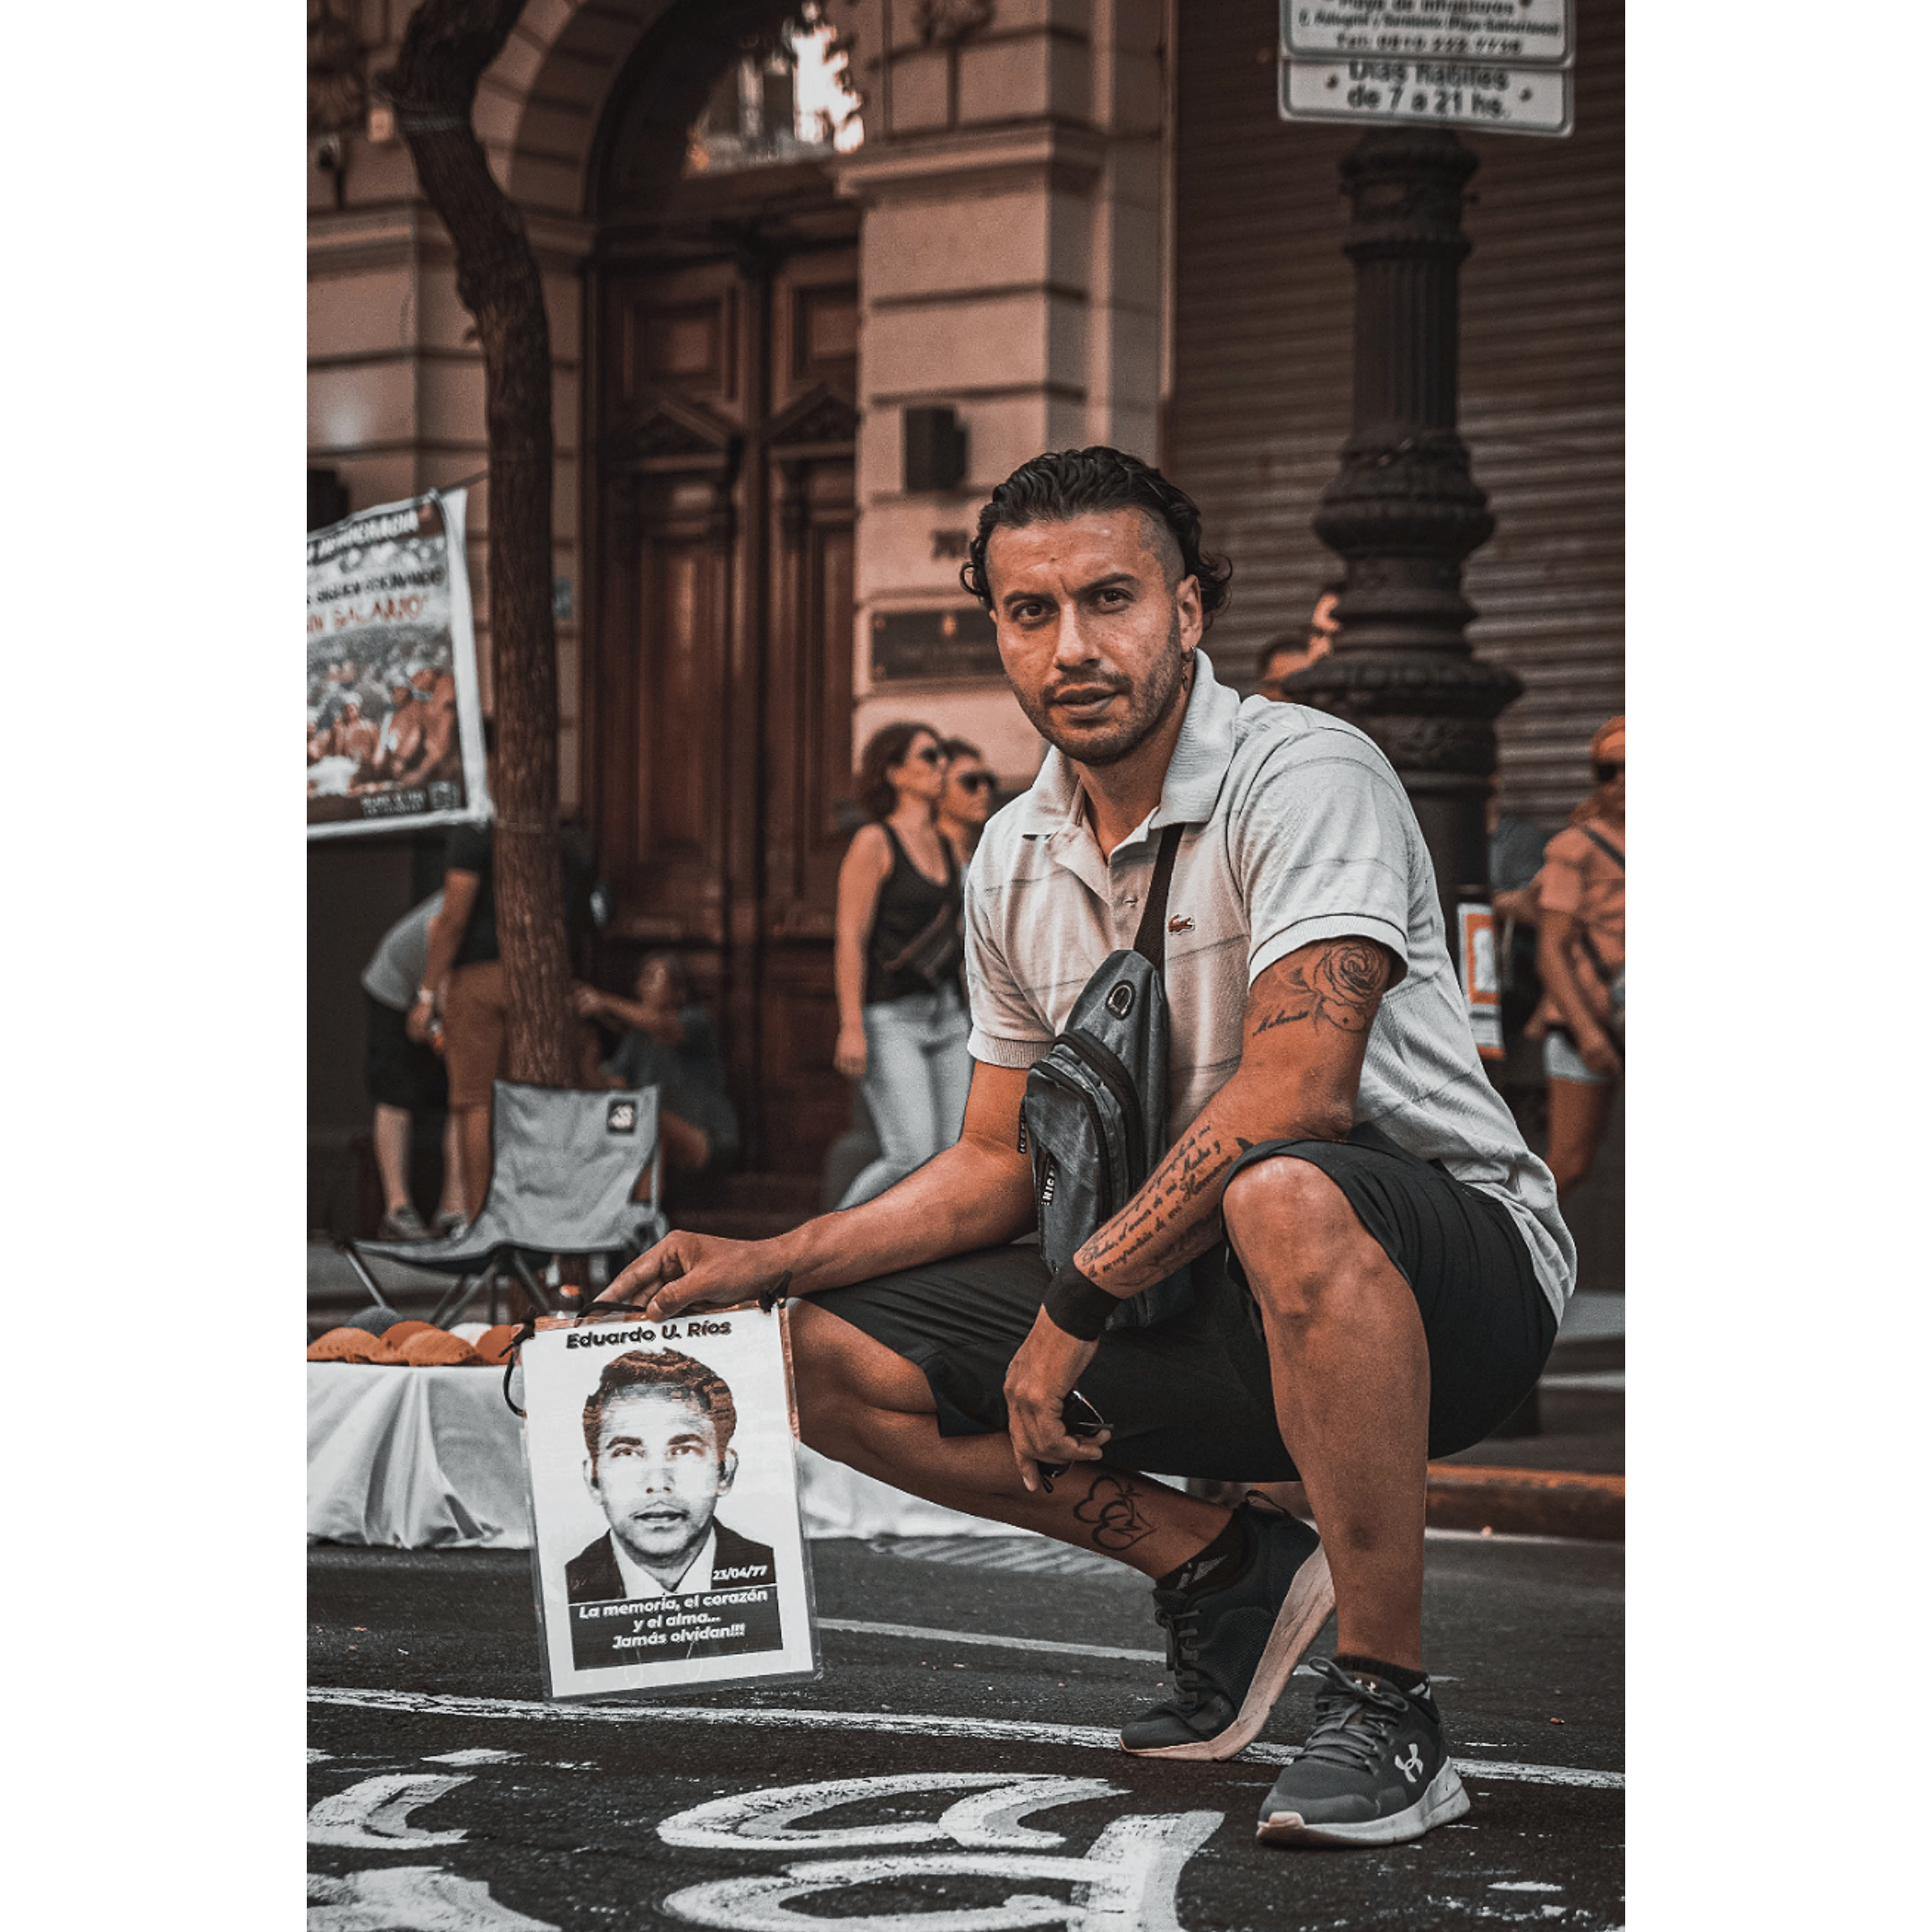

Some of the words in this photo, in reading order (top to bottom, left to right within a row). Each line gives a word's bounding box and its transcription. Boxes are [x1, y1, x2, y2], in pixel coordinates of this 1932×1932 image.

[1347, 84, 1380, 109] de
[1389, 86, 1404, 111] 7
[1411, 92, 1428, 113] a
[1435, 91, 1463, 115] 21
[565, 1326, 657, 1350] Eduardo
[660, 1324, 682, 1340] U.
[687, 1320, 732, 1338] Ríos
[712, 1564, 768, 1581] 23/04/77
[579, 1606, 601, 1620] La
[602, 1596, 681, 1617] memoria,
[683, 1593, 700, 1609] el
[702, 1588, 768, 1607] corazón
[612, 1631, 667, 1650] Jamás
[670, 1622, 746, 1644] olvidan!!!
[631, 1618, 644, 1633] y
[646, 1614, 662, 1629] el
[665, 1611, 722, 1627] alma...
